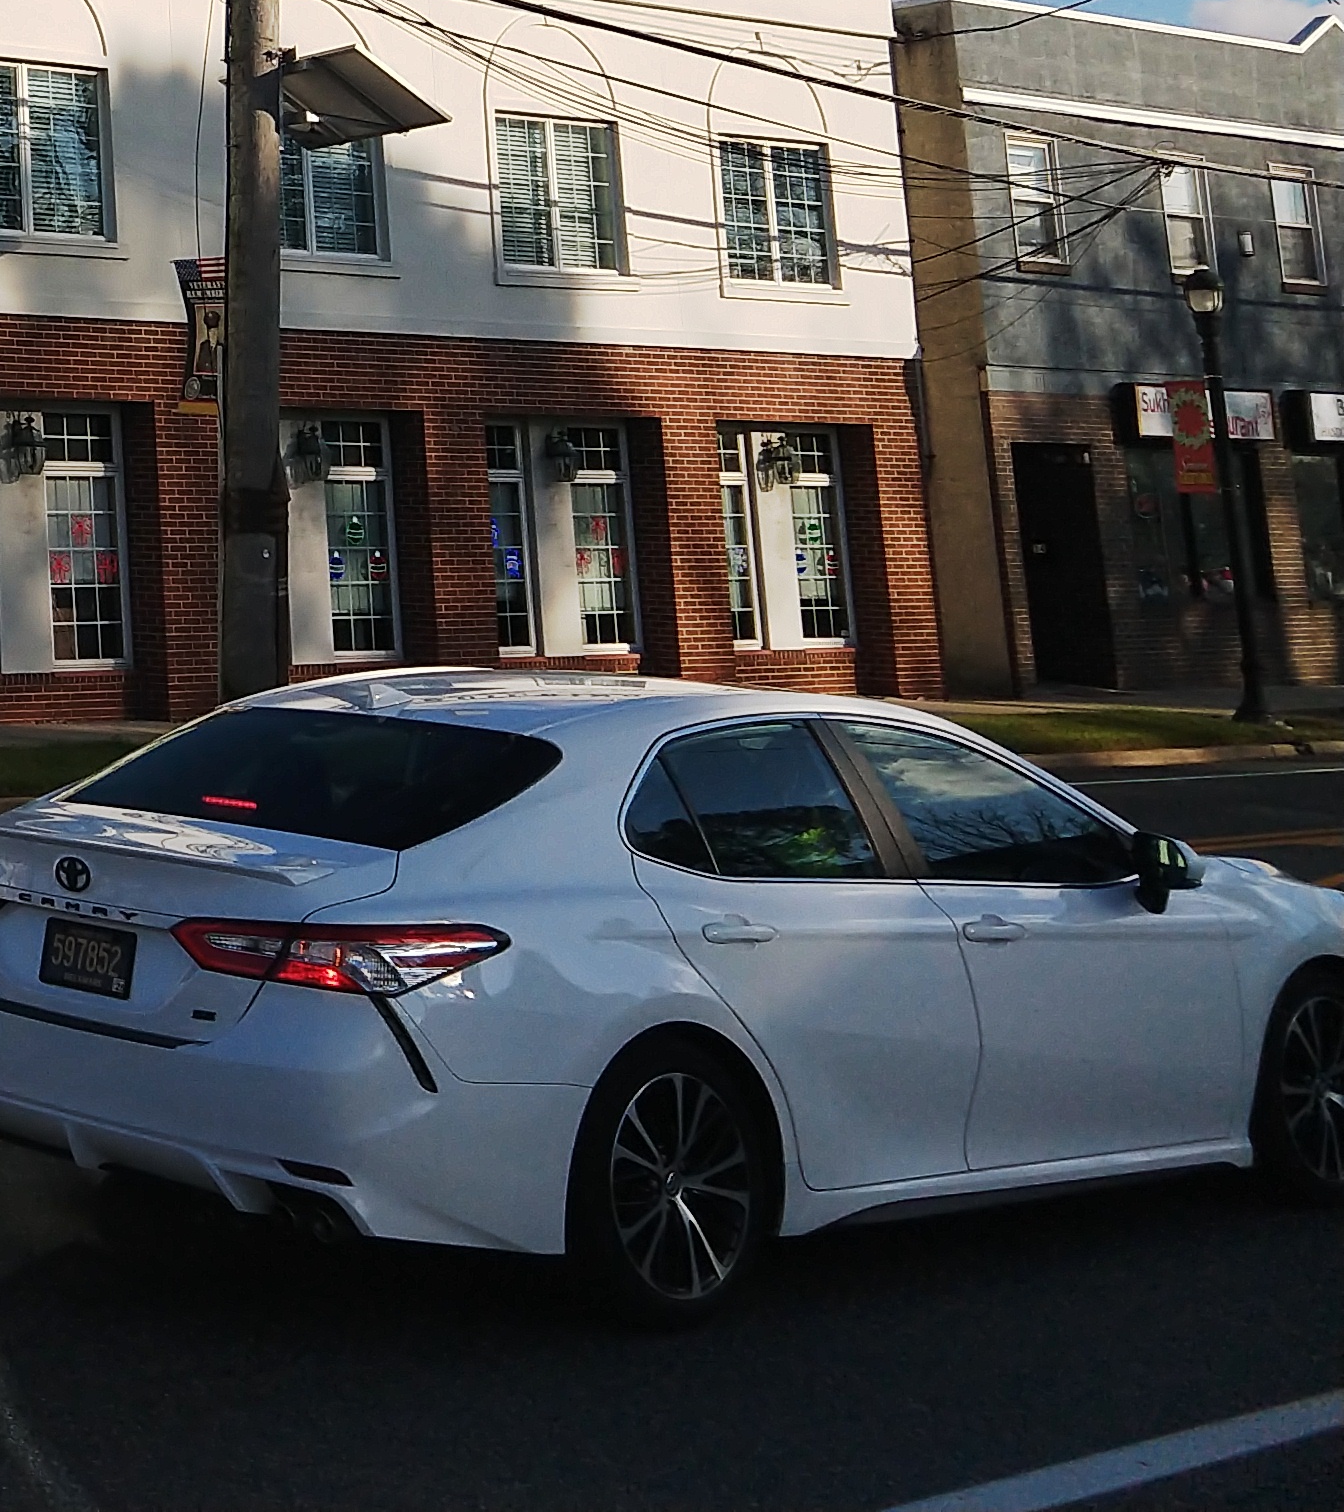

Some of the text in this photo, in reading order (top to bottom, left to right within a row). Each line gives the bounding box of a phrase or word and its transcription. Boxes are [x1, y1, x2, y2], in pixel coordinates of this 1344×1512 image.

[1141, 391, 1170, 413] Sukh
[18, 892, 140, 921] CAMRY
[51, 933, 122, 978] 597852
